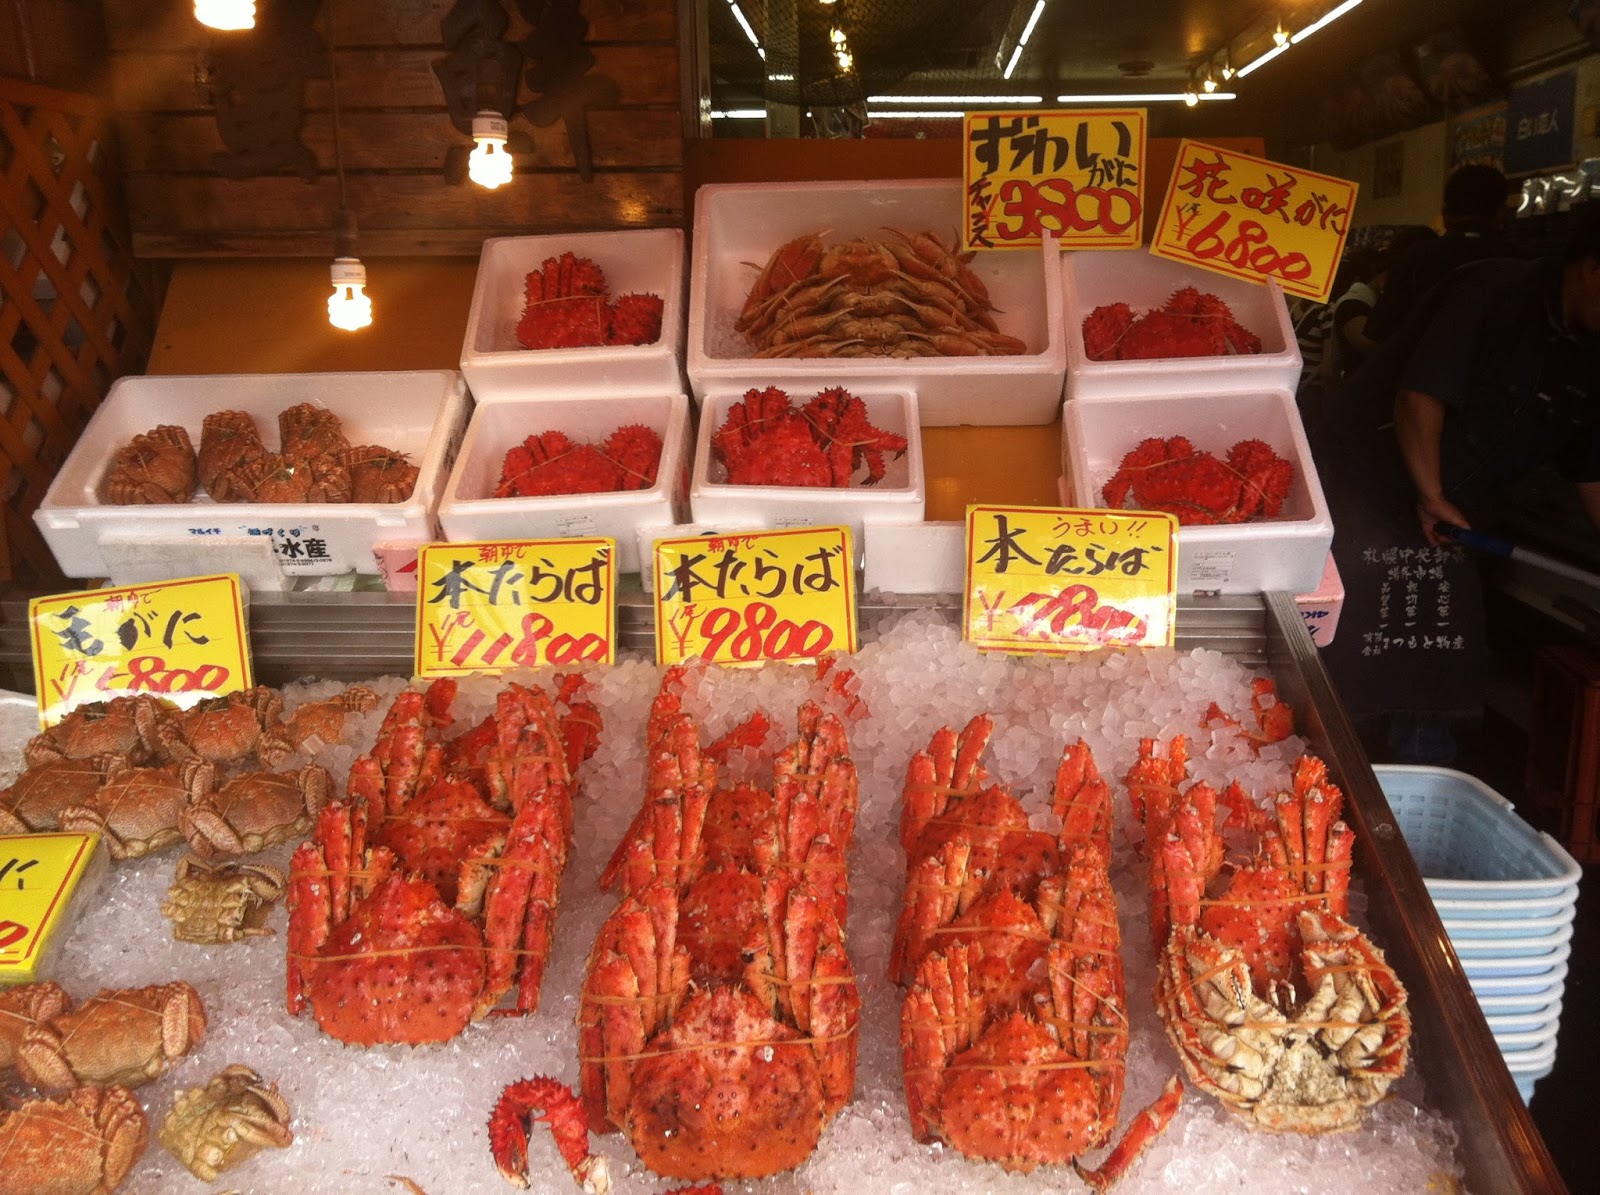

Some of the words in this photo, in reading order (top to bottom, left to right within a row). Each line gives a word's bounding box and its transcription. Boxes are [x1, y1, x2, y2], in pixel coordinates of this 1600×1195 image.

[1178, 153, 1348, 236] 花咲がに
[271, 537, 331, 558] 水産
[661, 545, 844, 603] 本たらば
[976, 514, 1164, 576] 本たらば
[428, 549, 608, 609] 本たらば
[52, 605, 209, 657] 毛がに
